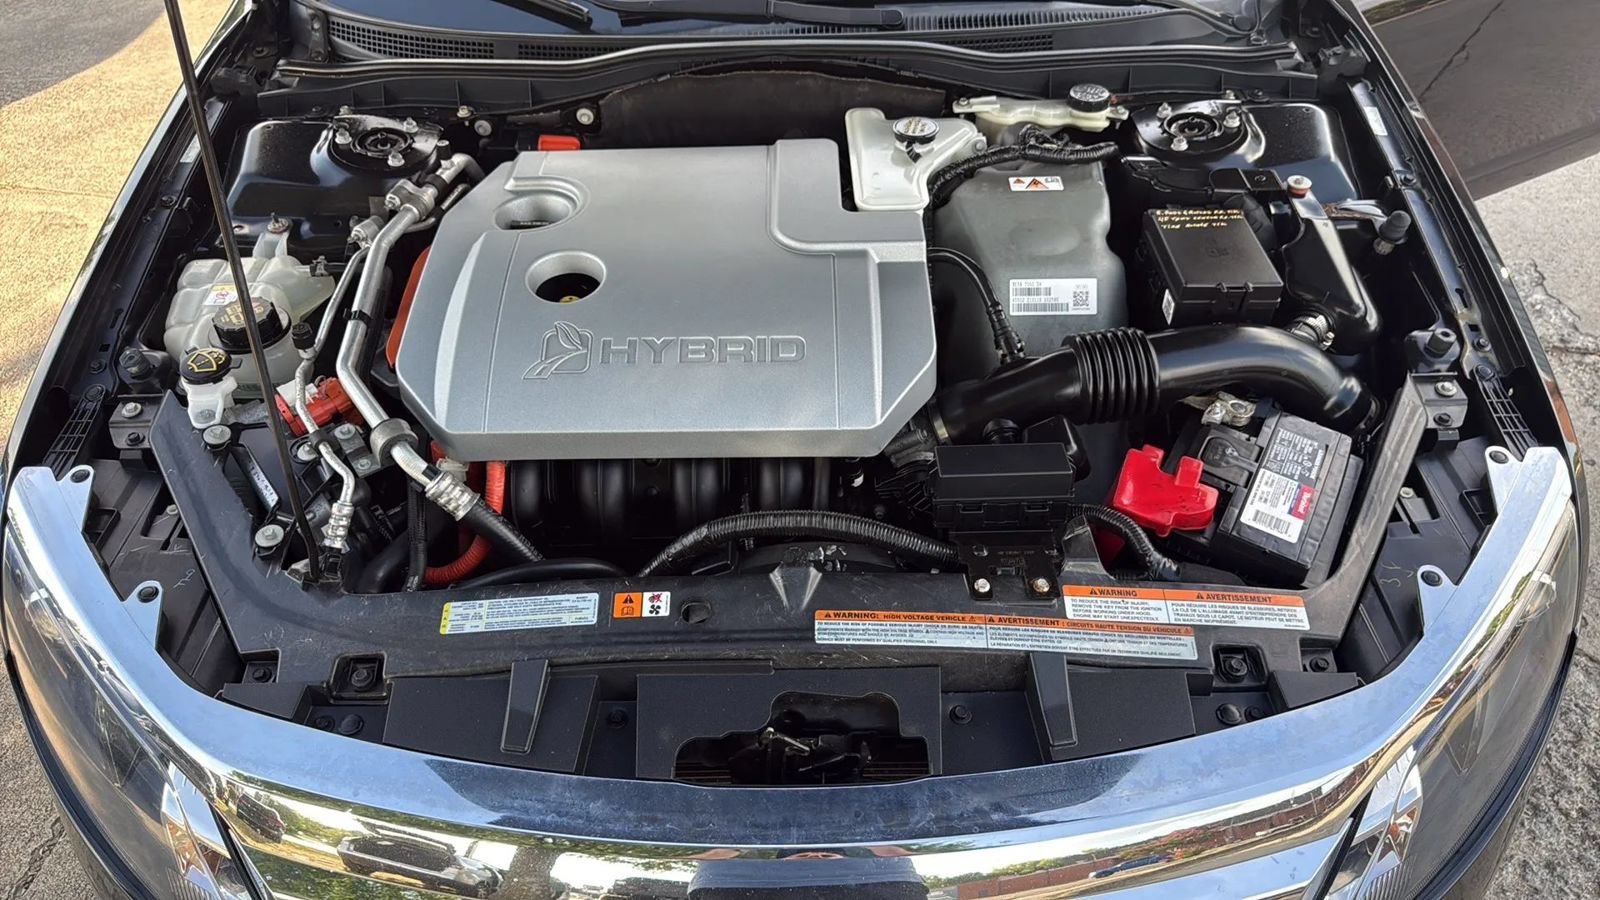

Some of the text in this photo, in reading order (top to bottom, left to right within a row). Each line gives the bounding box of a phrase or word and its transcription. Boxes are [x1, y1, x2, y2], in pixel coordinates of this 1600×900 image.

[600, 335, 807, 364] HYBRID
[1206, 593, 1272, 602] AVERTISSEMENT
[998, 617, 1059, 626] AVERTISSEMENT
